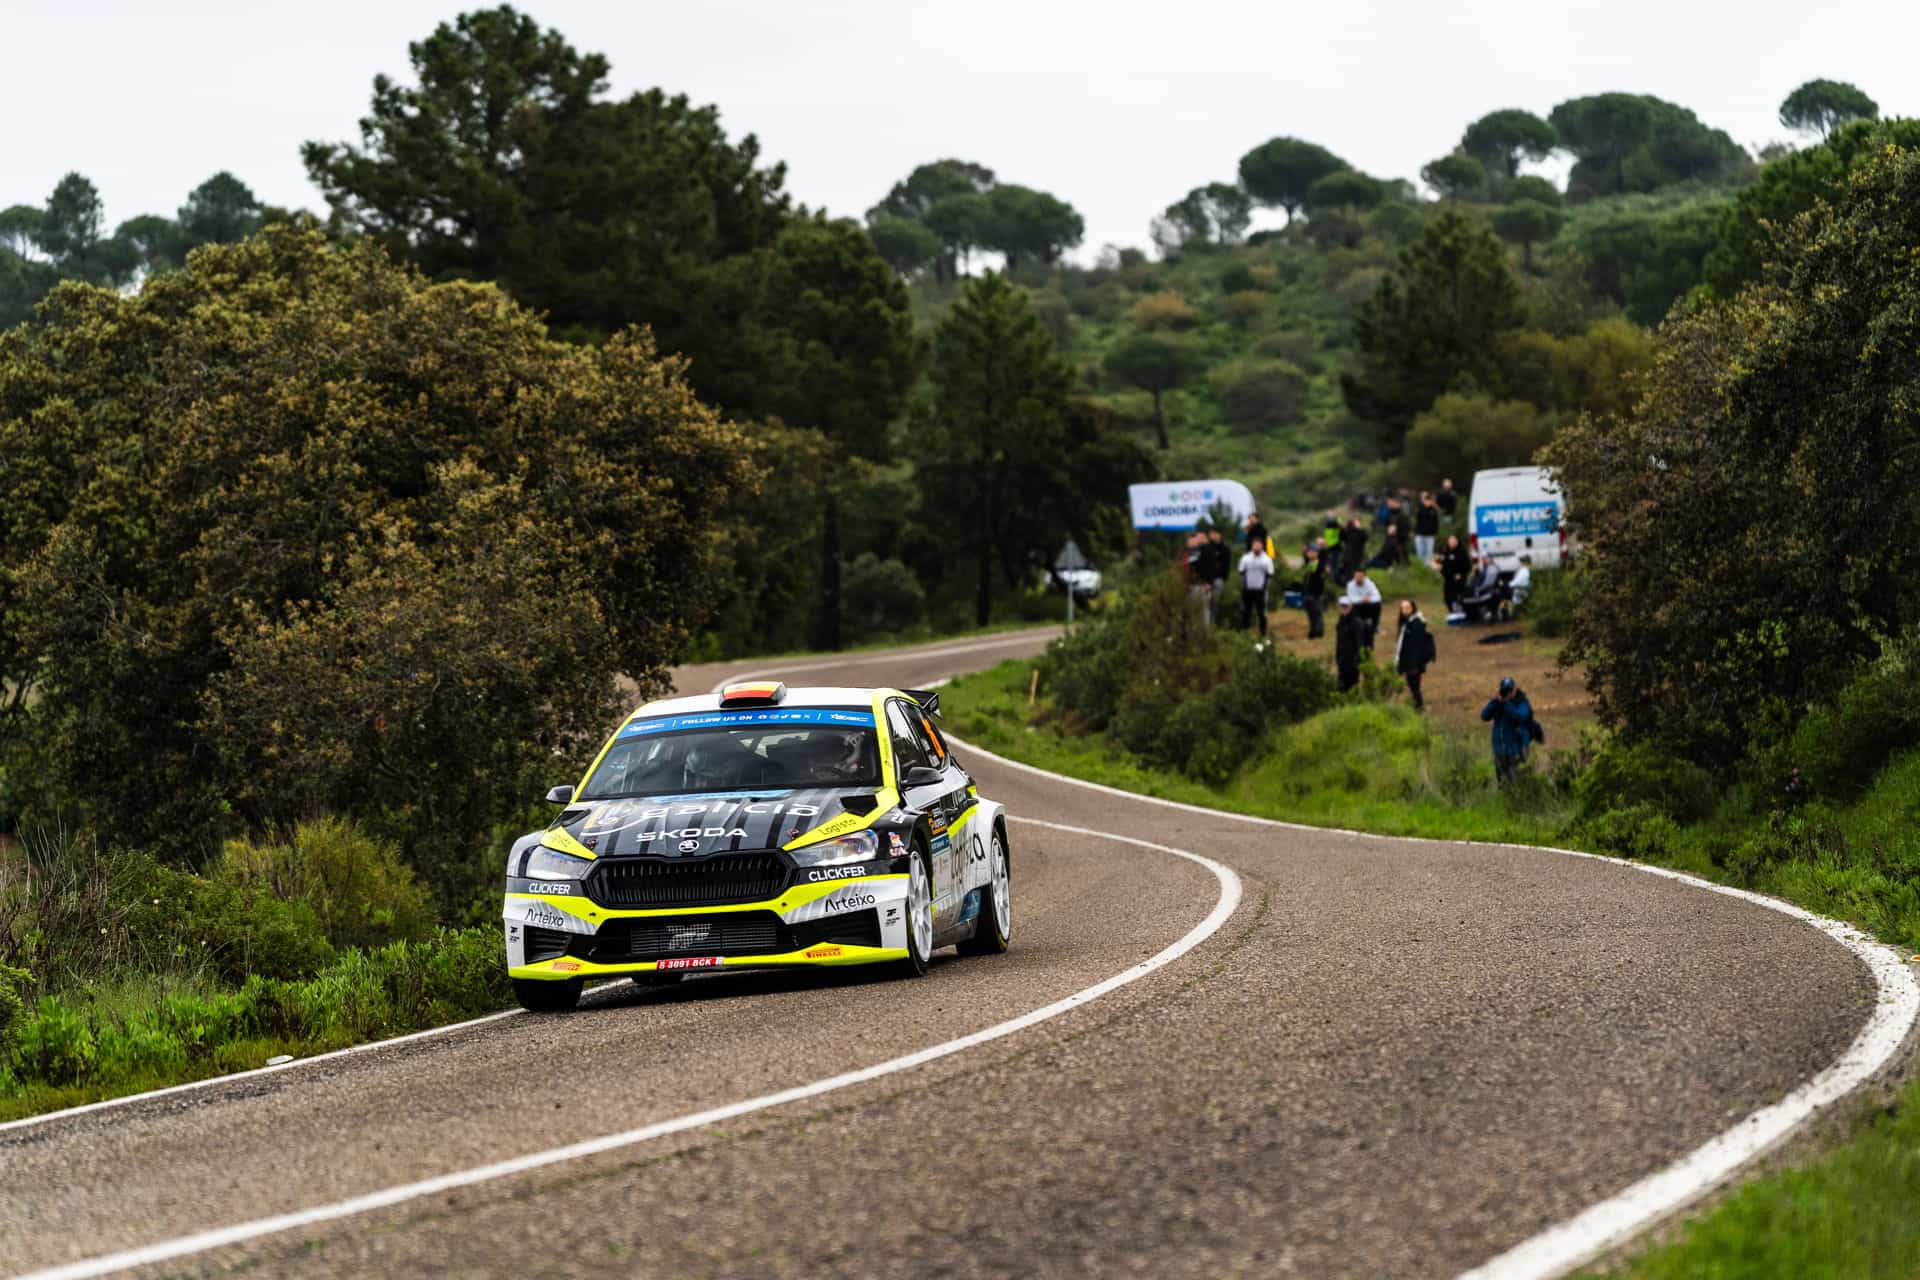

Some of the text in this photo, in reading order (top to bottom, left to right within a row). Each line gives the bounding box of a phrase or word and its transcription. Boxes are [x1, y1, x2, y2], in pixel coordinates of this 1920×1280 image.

[808, 865, 866, 882] CLICKFER
[528, 882, 571, 895] CLICKFER
[825, 893, 876, 913] Arteixo
[524, 908, 564, 927] Arteixo
